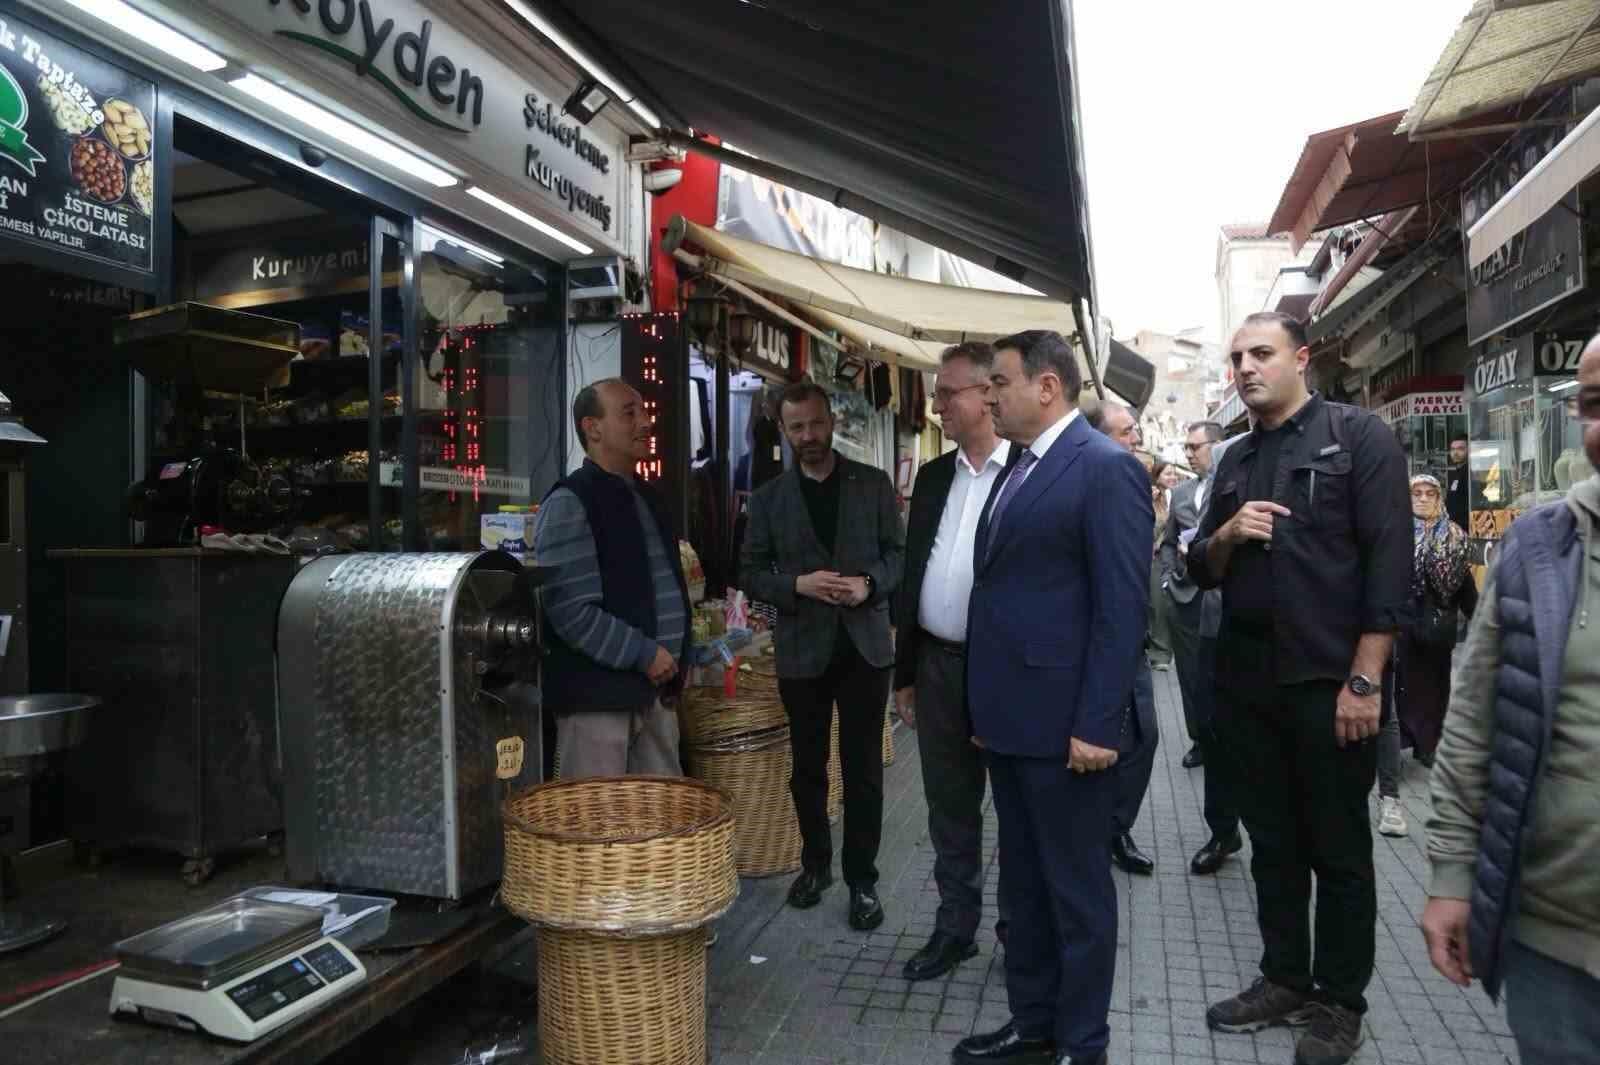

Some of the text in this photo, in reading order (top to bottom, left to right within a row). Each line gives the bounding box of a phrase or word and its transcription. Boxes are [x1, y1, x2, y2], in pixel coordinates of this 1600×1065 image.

[526, 144, 611, 232] Kuruyemiş
[43, 207, 145, 249] ÇİKOLATASI
[64, 193, 128, 227] İSTEME
[1474, 349, 1518, 394] ÖZAY
[1414, 395, 1463, 405] MERVE
